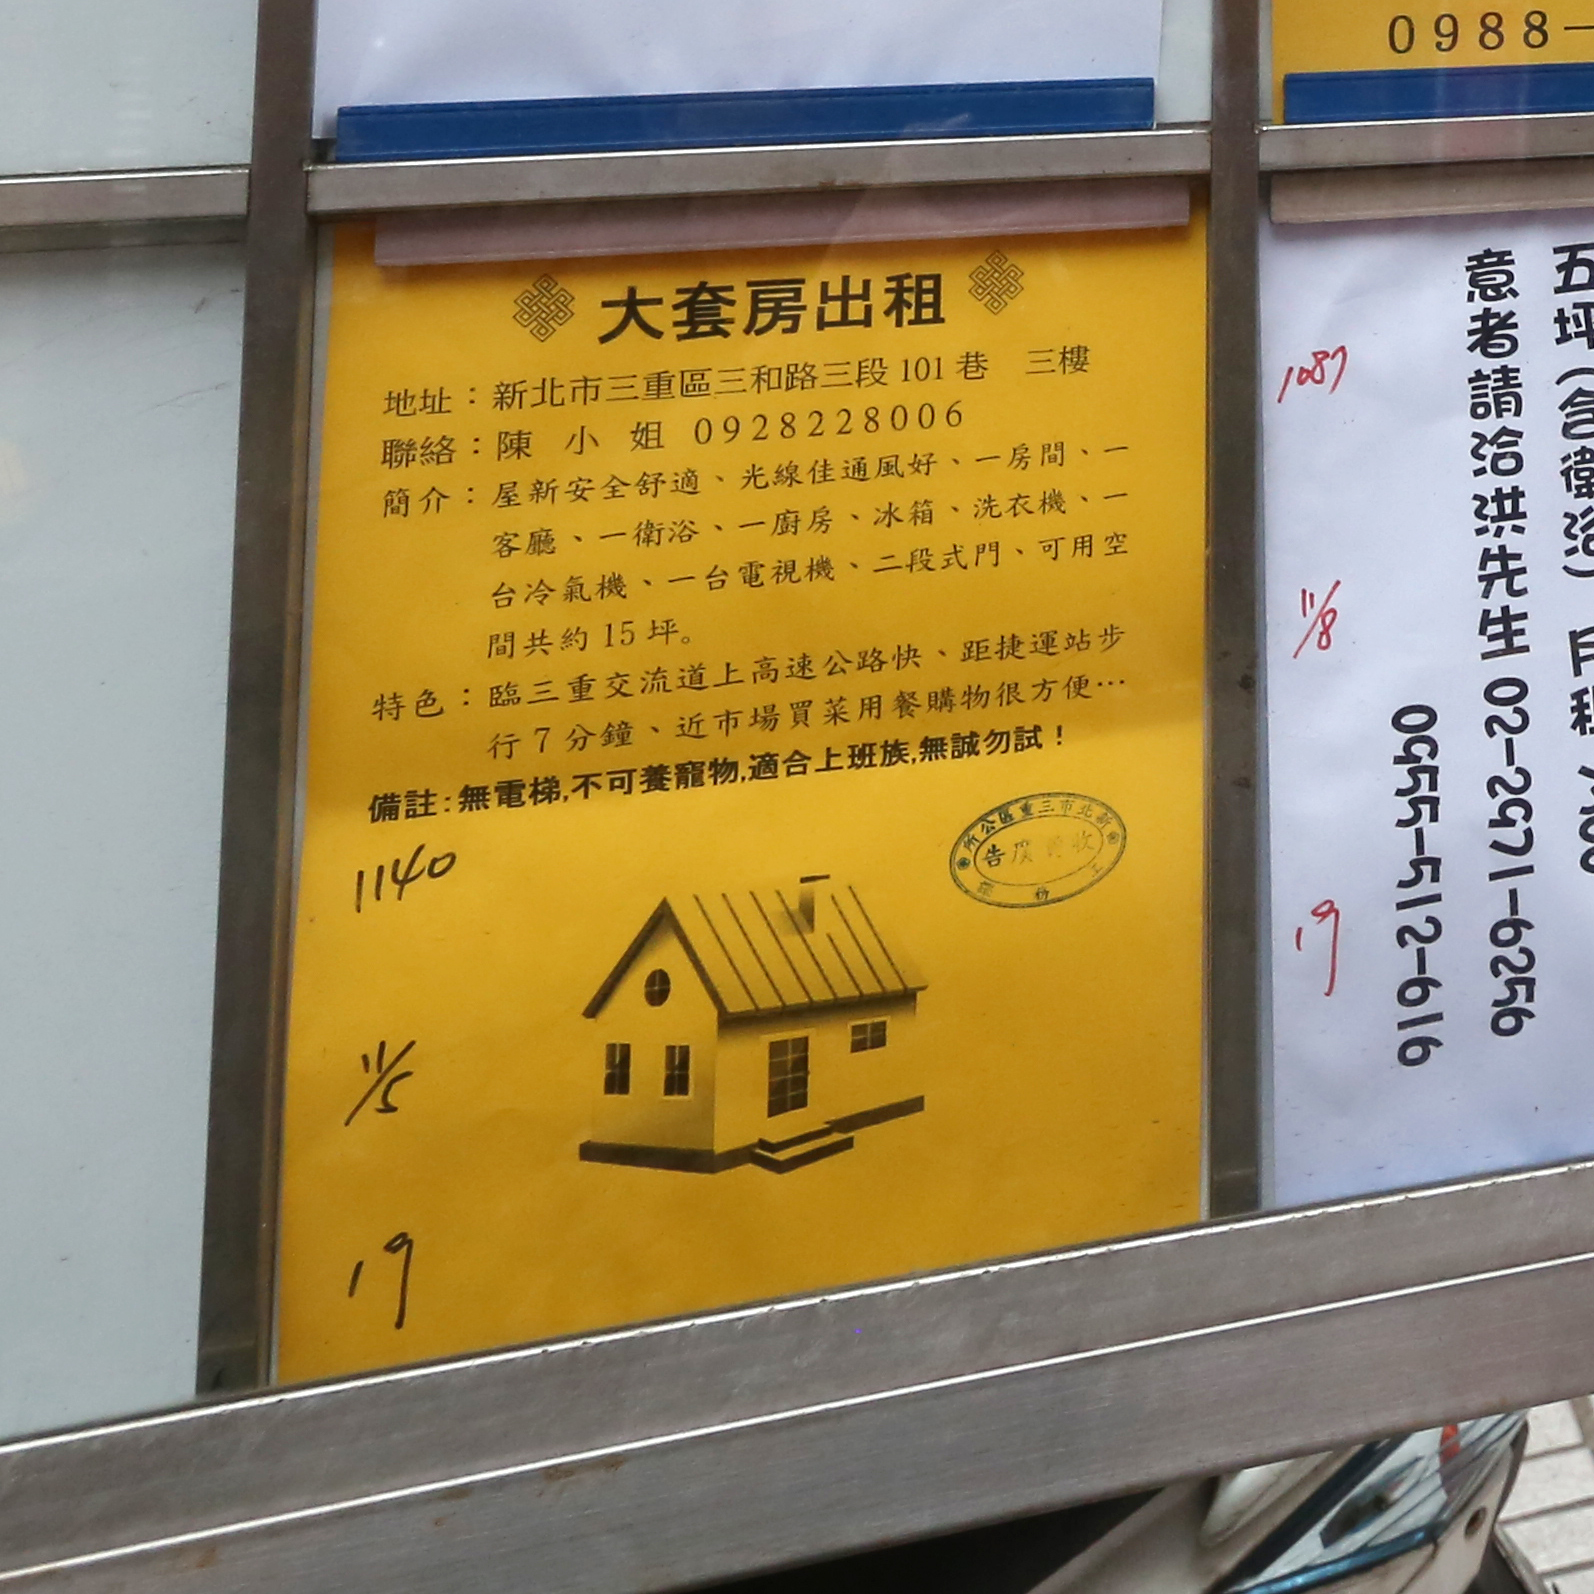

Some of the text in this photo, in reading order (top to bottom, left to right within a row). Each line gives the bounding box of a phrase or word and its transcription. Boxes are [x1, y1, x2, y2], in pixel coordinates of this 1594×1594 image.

[597, 271, 947, 345] 大套房出租
[694, 399, 964, 445] 0928228006
[1463, 246, 1538, 1039] 意者請洽洪先生 02-2971-6256
[1390, 703, 1445, 1068] 0955-512-616
